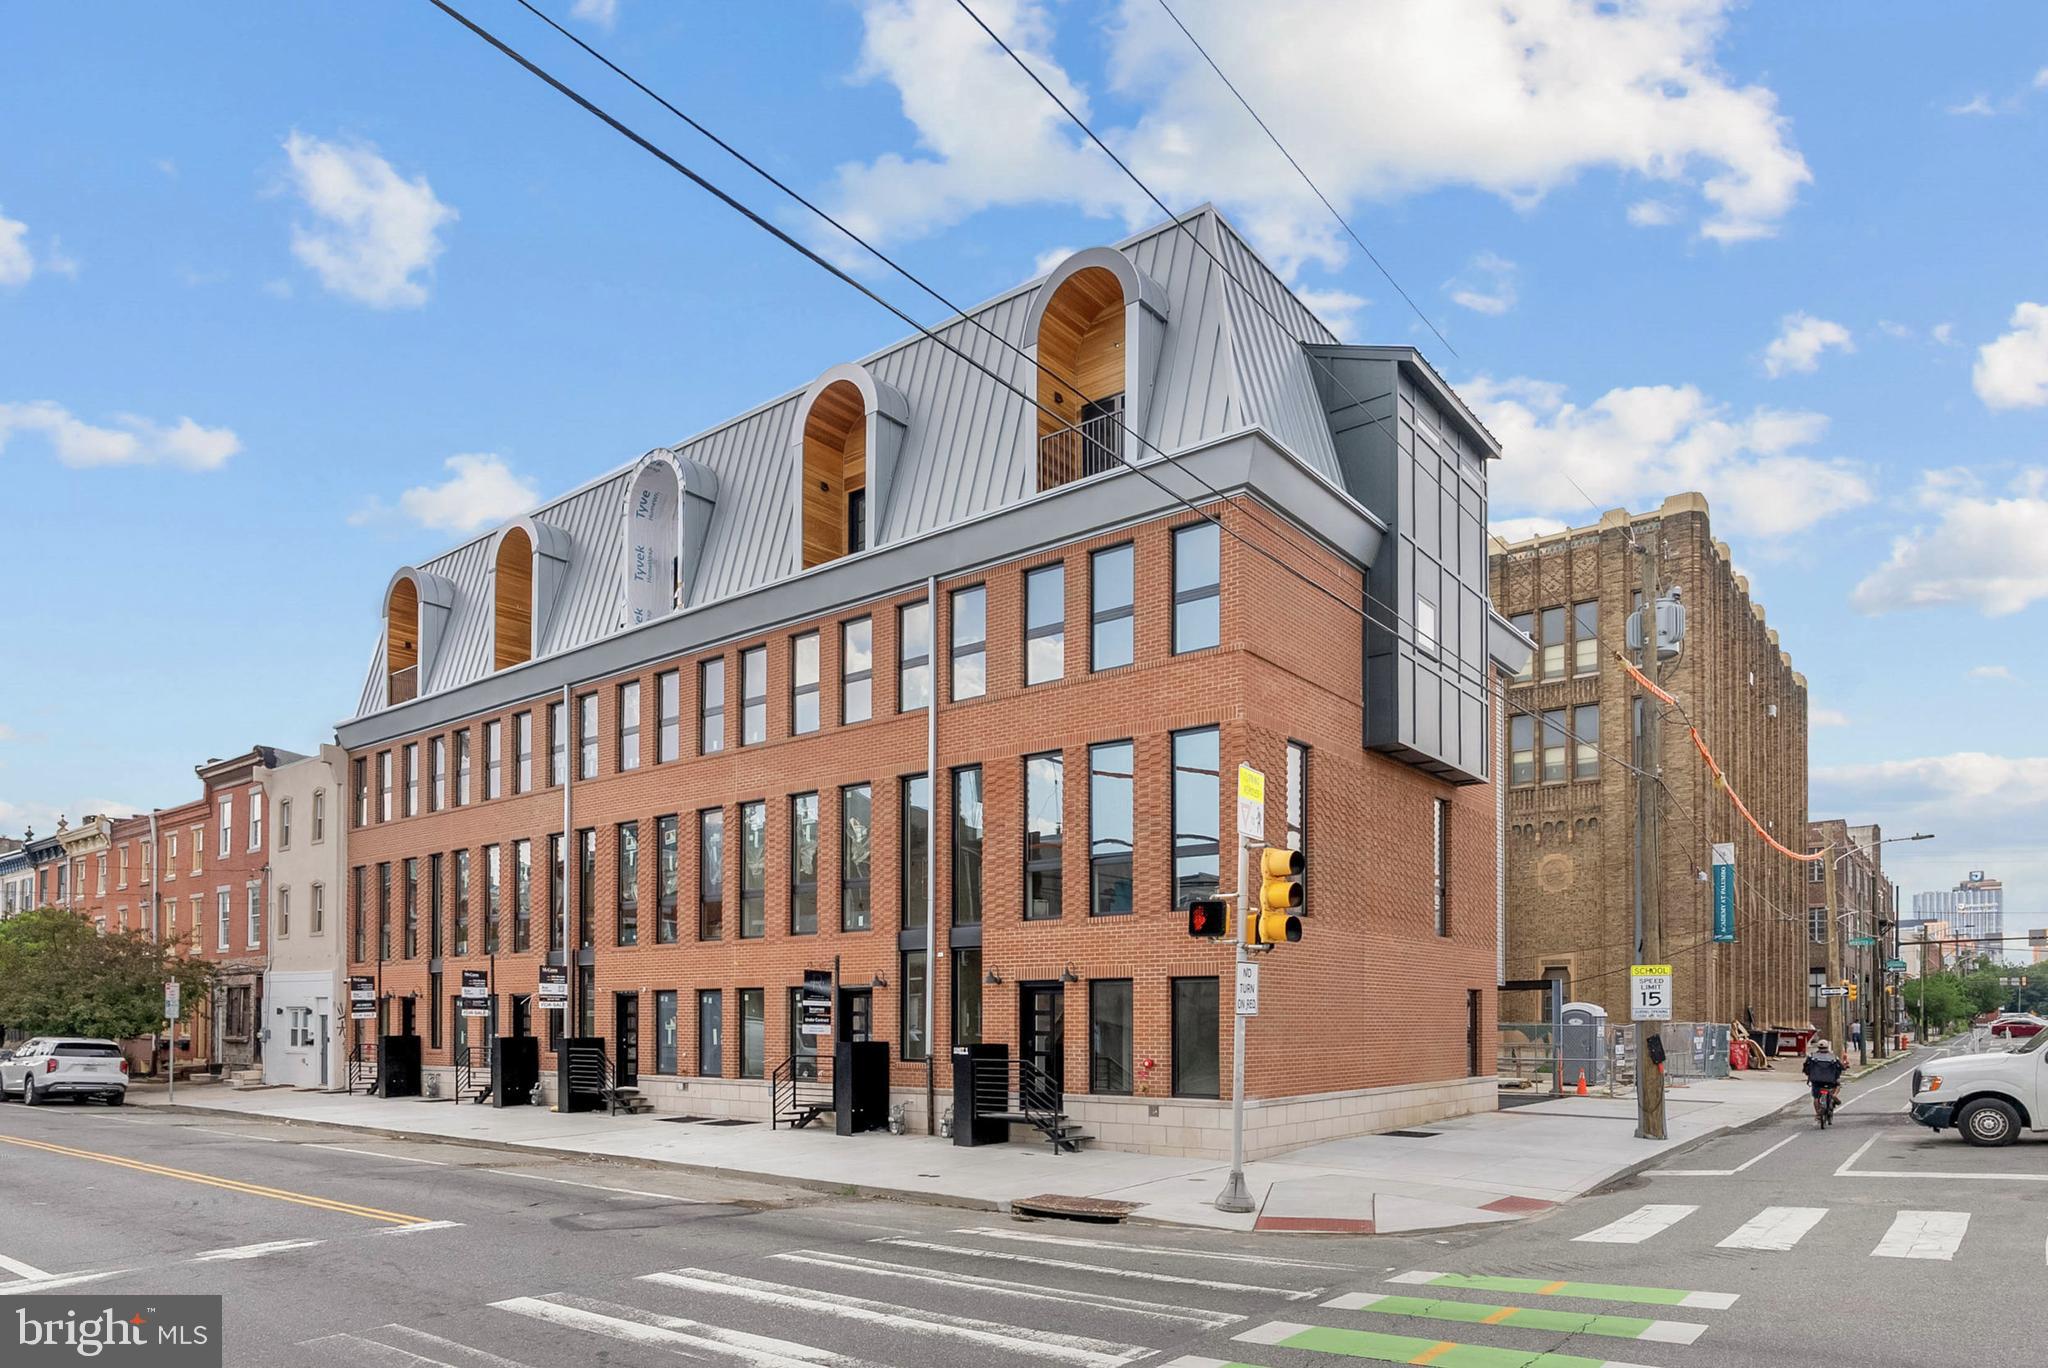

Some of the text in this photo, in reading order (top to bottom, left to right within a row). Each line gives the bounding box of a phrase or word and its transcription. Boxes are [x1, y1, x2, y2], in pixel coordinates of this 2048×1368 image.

[636, 490, 650, 518] Tyve
[634, 545, 645, 580] Tyvek
[634, 608, 642, 625] ek
[1243, 968, 1251, 977] NO
[1634, 967, 1669, 975] SCHOOL
[1240, 983, 1255, 993] TURN
[1238, 999, 1256, 1008] ON RED
[1641, 991, 1661, 1006] 15
